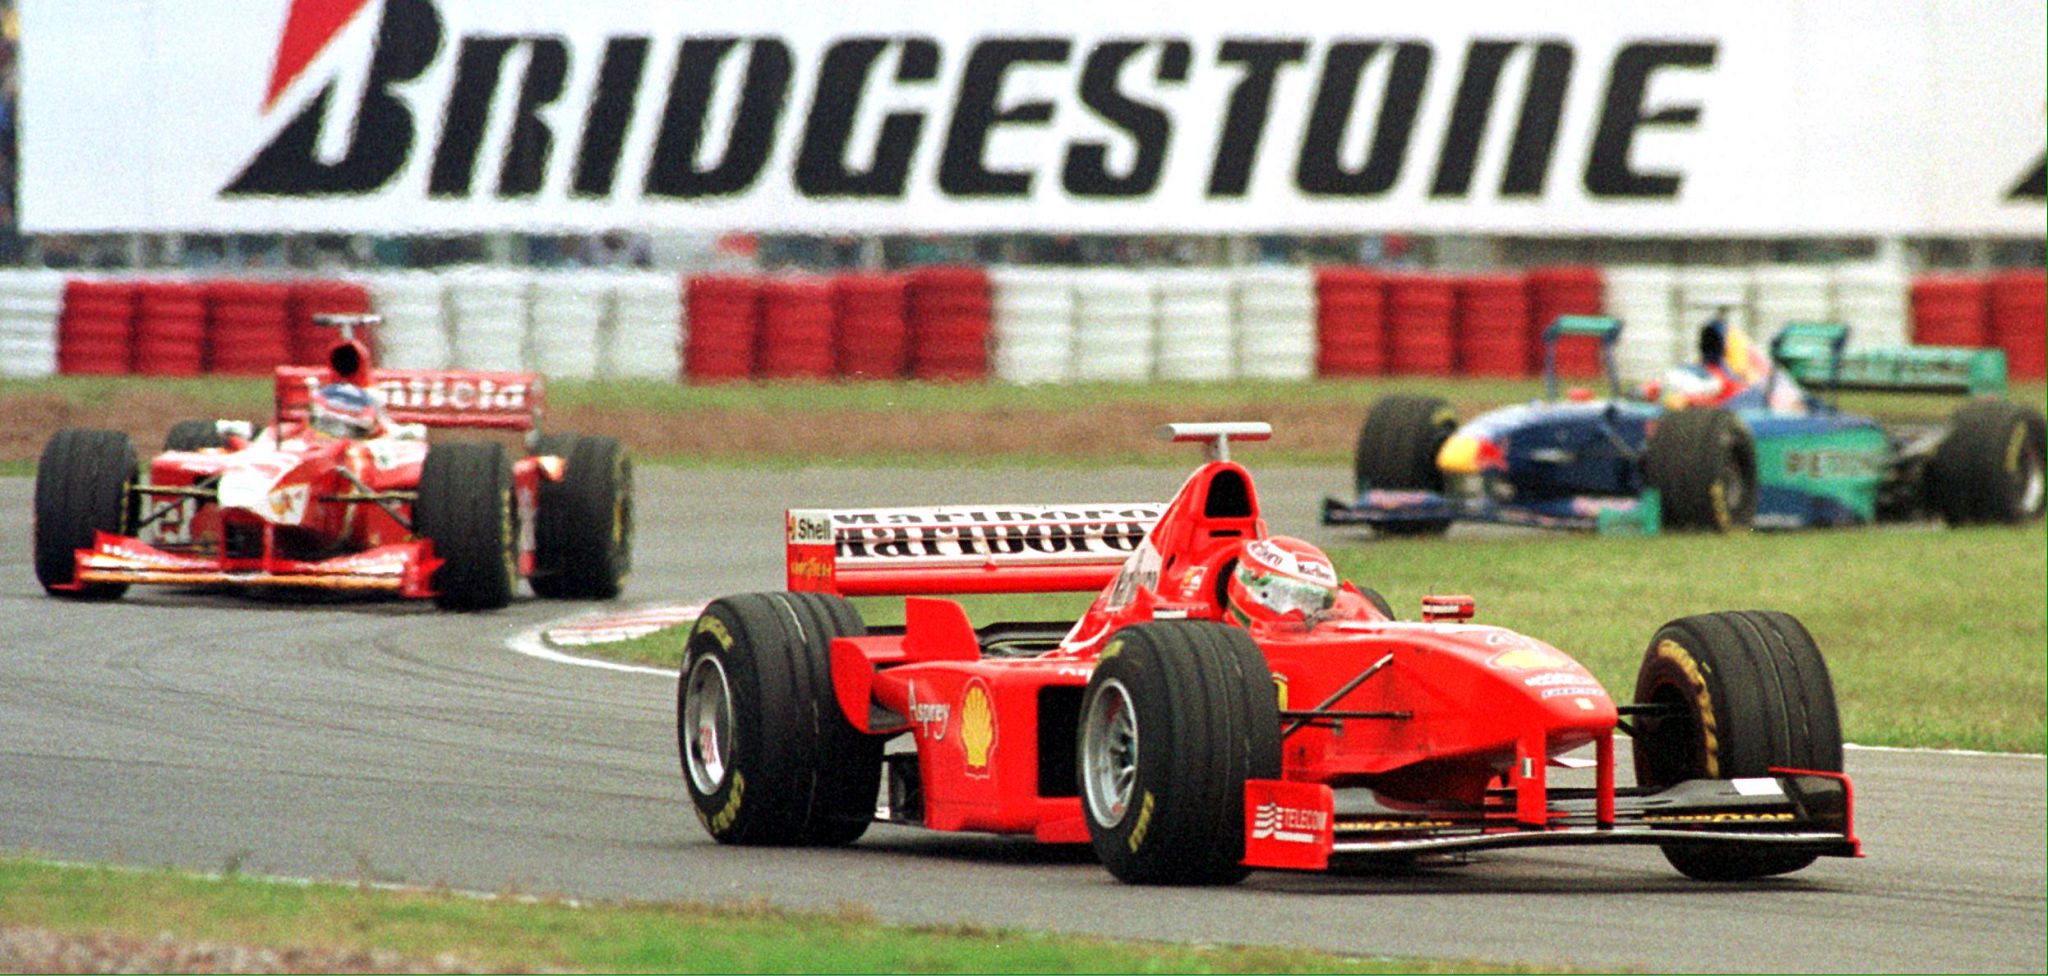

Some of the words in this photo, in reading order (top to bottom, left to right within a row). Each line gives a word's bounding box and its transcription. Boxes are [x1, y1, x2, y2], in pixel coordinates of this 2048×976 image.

[218, 0, 1719, 199] BRIDGESTONE
[798, 518, 831, 541] Shell
[908, 677, 951, 741] Asprey
[1284, 808, 1329, 831] TELECOM
